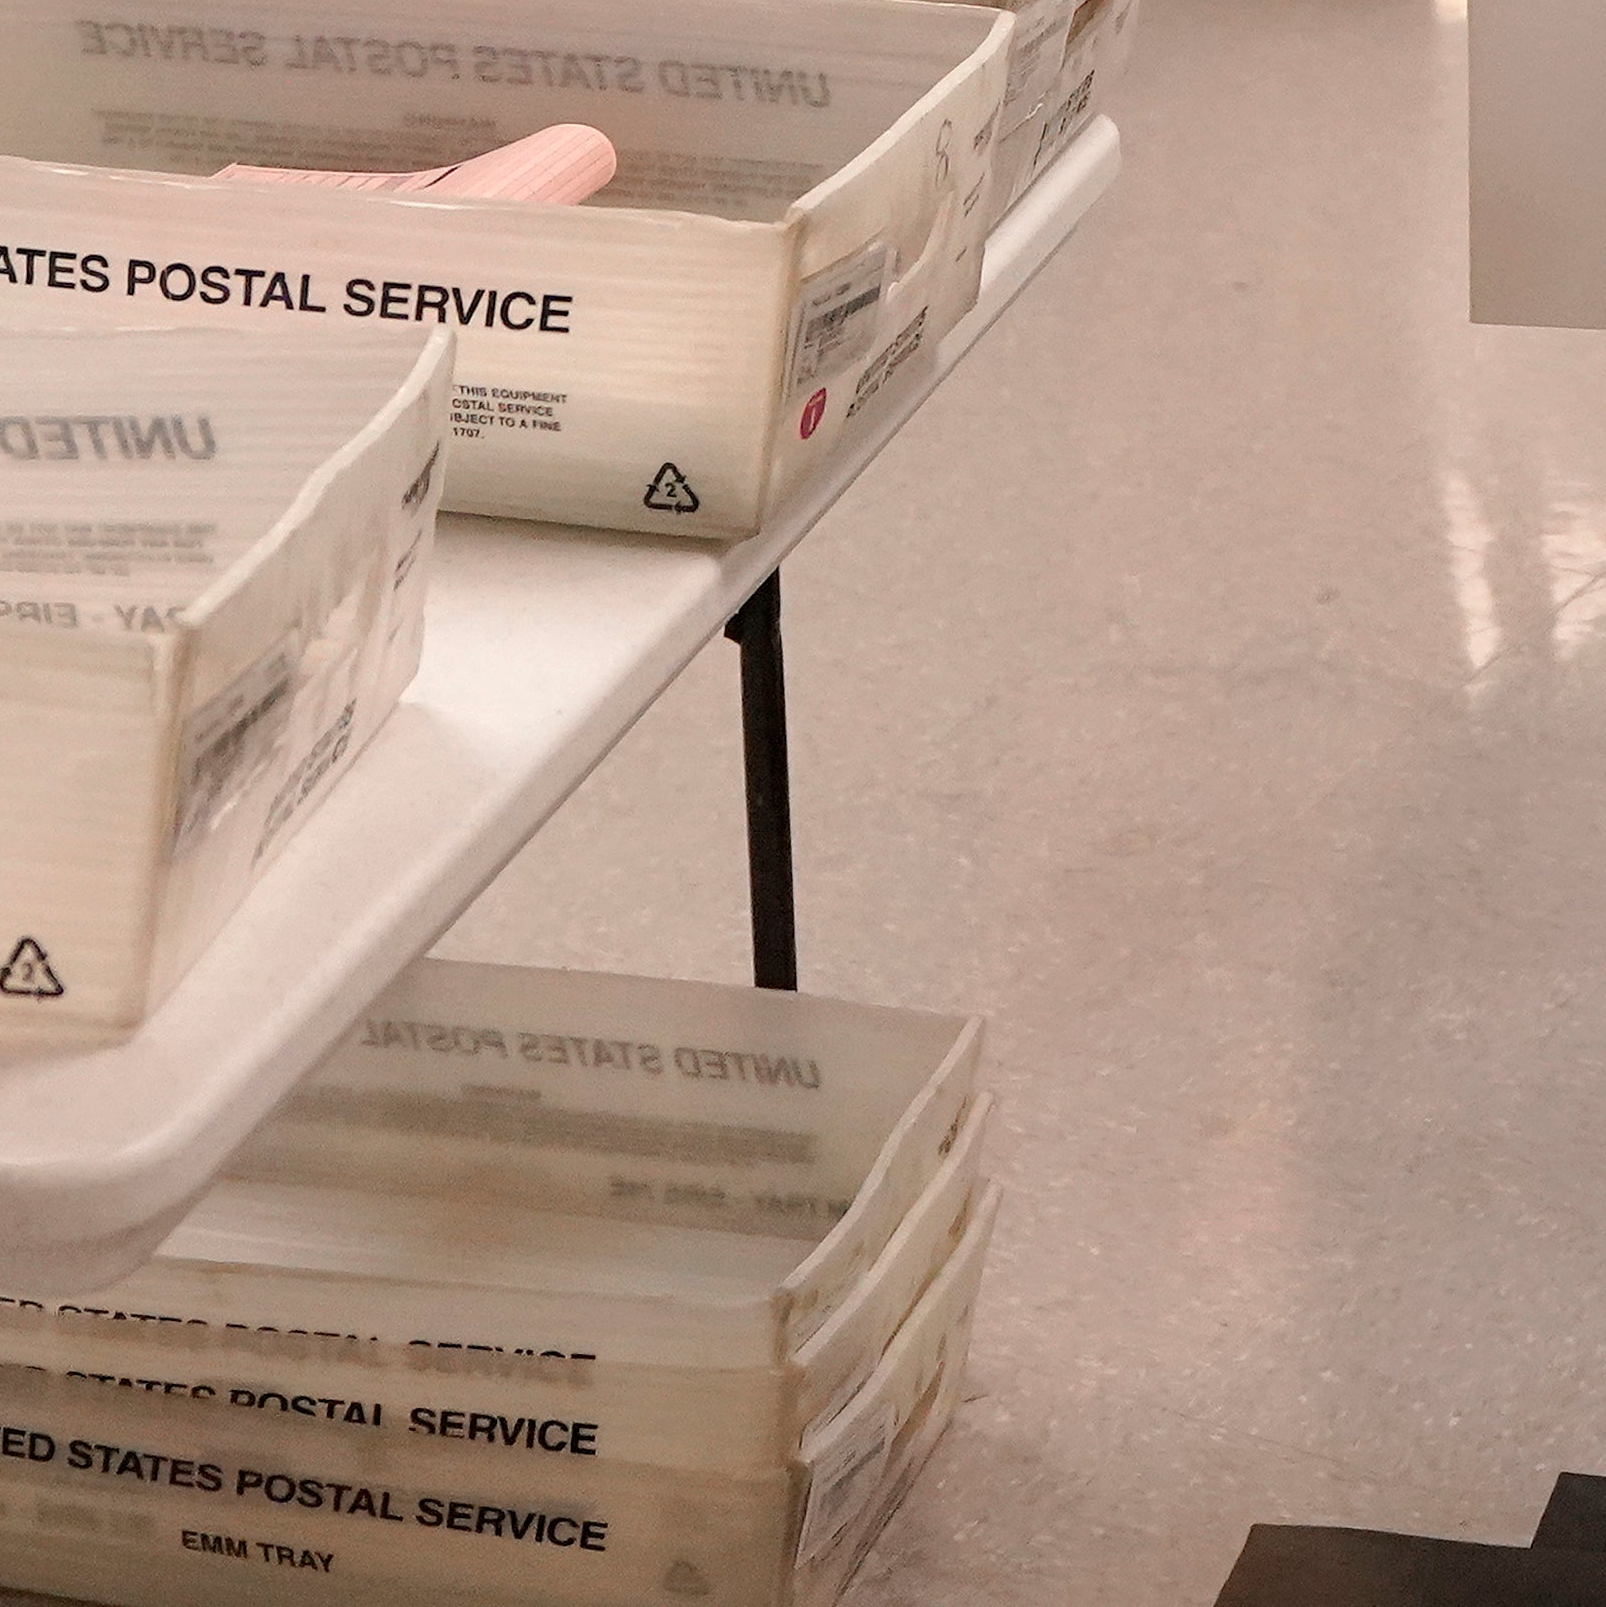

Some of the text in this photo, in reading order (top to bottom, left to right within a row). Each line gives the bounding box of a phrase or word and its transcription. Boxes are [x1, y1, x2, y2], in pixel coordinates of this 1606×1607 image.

[126, 258, 327, 313] POSTAL
[343, 275, 574, 334] SERVICE
[452, 397, 554, 417] OSTAL SERVICE
[492, 388, 568, 404] EQUIPMENT
[450, 412, 562, 432] BJECT TO A FINE
[408, 1406, 600, 1457] SERVICE
[67, 1439, 223, 1493] STATES
[235, 1469, 404, 1523] POSTAL
[415, 1497, 610, 1553] SERVICE
[181, 1528, 335, 1574] EMM TRAY
